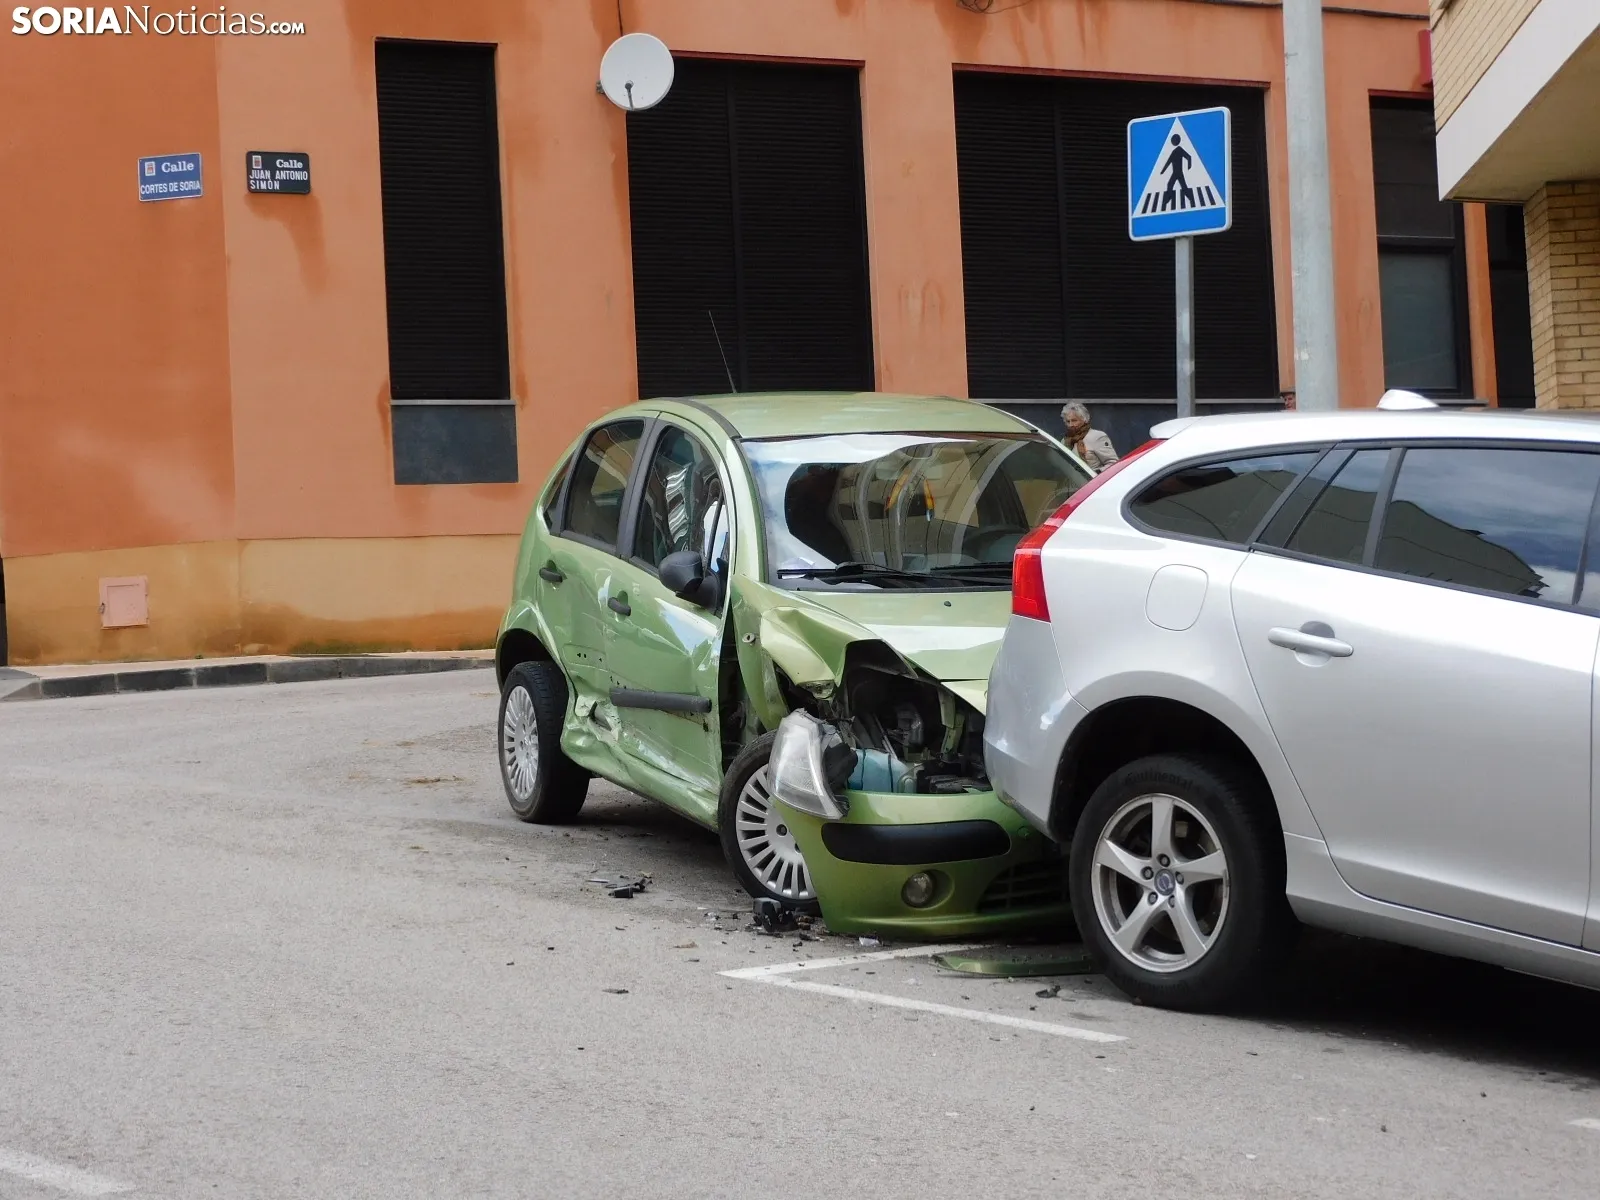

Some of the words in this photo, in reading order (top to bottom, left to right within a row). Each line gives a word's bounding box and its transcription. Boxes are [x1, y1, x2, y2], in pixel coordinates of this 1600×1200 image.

[161, 161, 195, 173] Calle
[275, 159, 304, 169] Calle
[249, 169, 271, 180] JUAN
[275, 170, 308, 181] ANTONIO
[140, 183, 168, 195] CORTES
[168, 182, 179, 192] DE
[179, 180, 201, 191] SORIA
